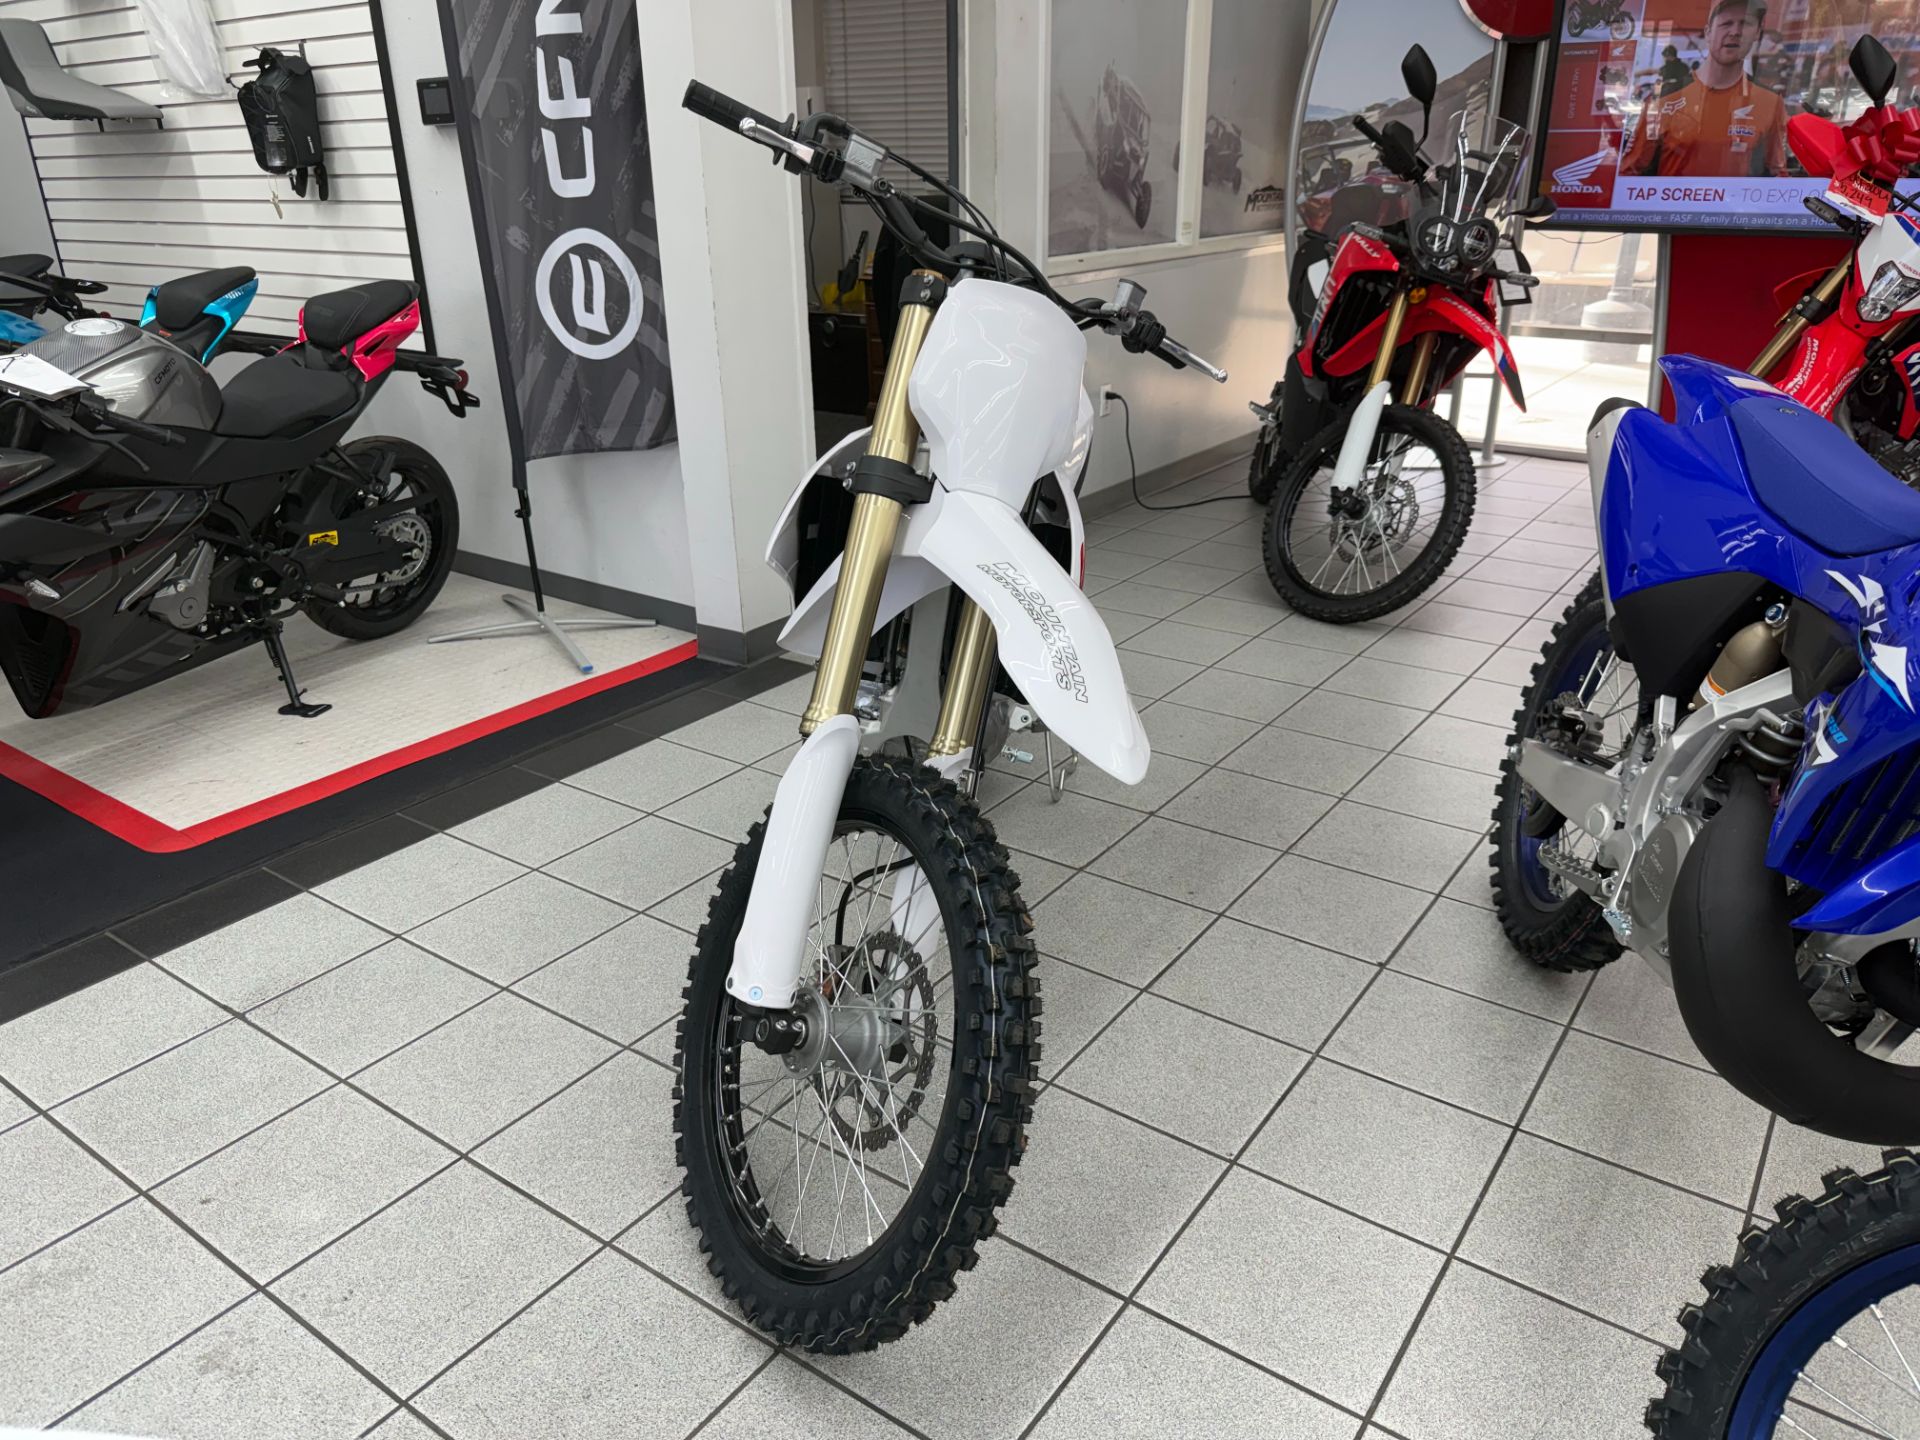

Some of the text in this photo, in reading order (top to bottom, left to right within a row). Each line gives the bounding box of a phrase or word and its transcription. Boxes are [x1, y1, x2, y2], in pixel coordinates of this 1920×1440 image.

[1551, 185, 1603, 193] HONDA
[1627, 187, 1657, 201] TAP
[1660, 187, 1725, 202] SCREEN
[1742, 188, 1762, 203] TO
[1581, 212, 1610, 221] Honda
[1612, 213, 1662, 223] motorcycle
[1700, 214, 1729, 225] family
[1732, 214, 1749, 224] fun
[1751, 215, 1783, 225] awaits
[1785, 217, 1798, 225] on
[1800, 218, 1807, 226] a
[1353, 234, 1381, 258] RALLY
[154, 358, 177, 384] CFMOTO
[976, 564, 1072, 691] MOTORSPORTS
[993, 562, 1088, 704] MOUNTAIN
